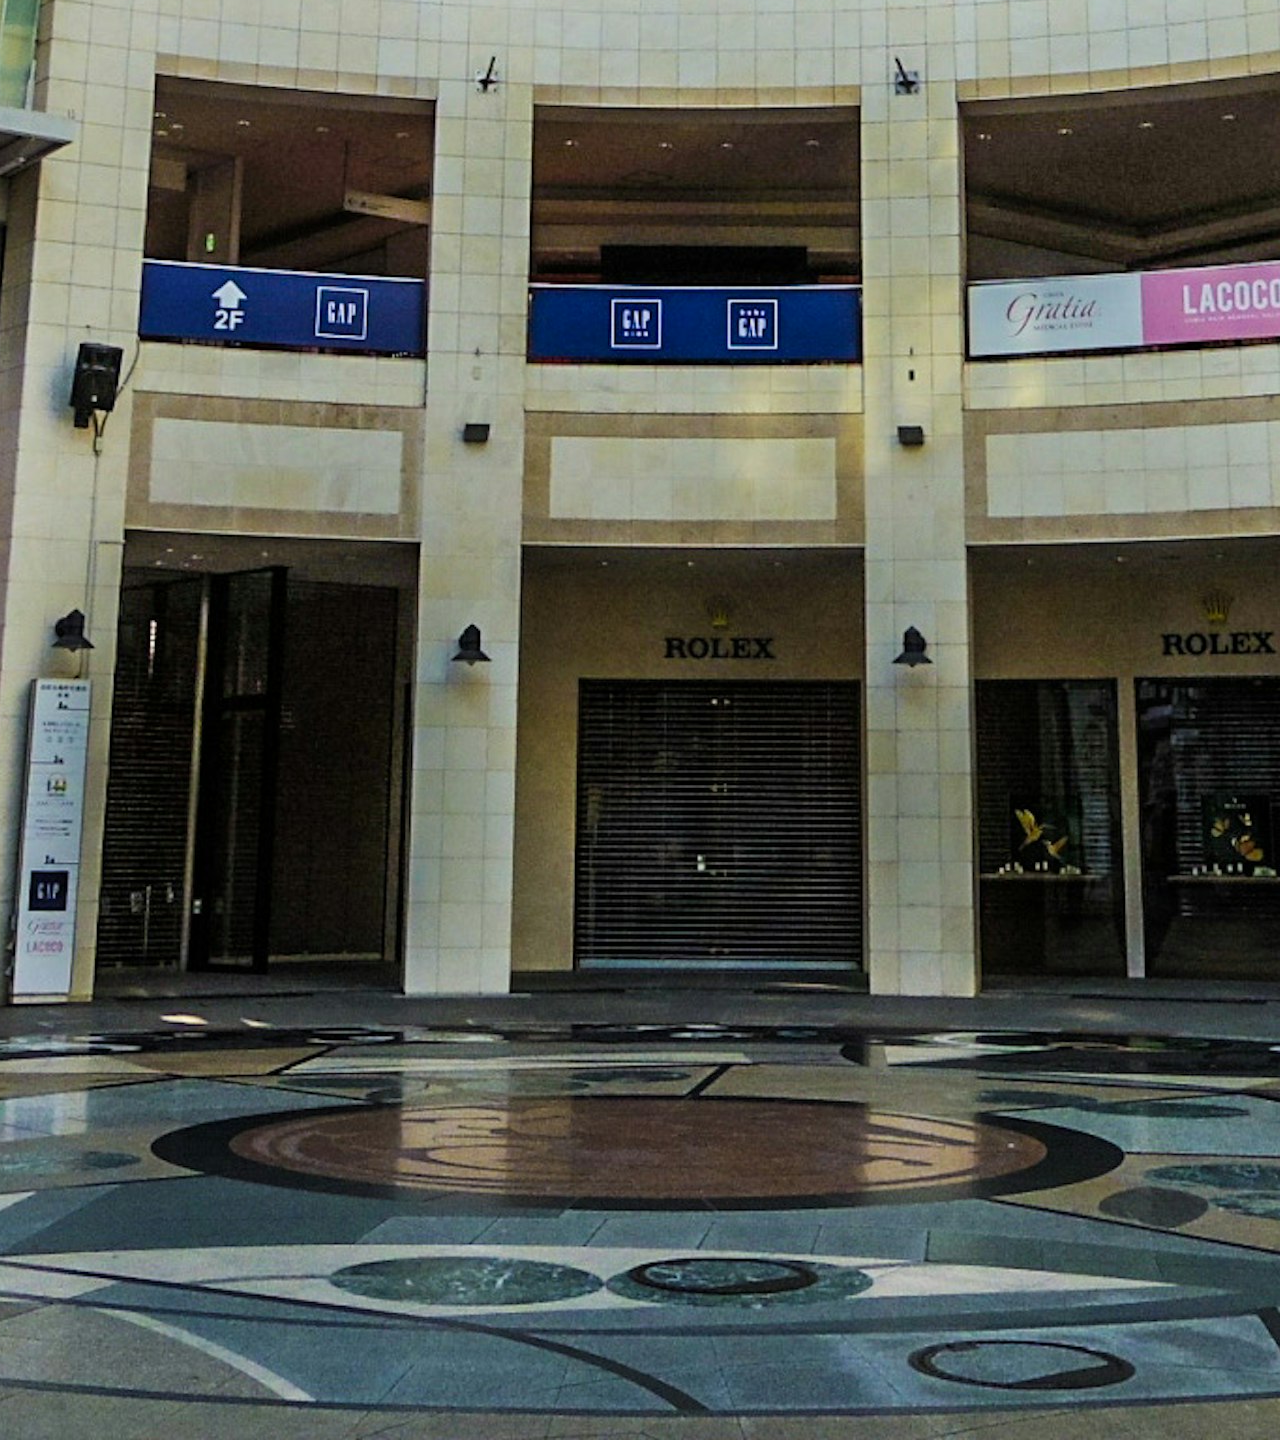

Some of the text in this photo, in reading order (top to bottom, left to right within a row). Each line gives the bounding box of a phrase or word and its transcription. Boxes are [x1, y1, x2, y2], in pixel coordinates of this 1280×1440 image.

[213, 310, 246, 331] 2F
[327, 301, 357, 325] GAP
[622, 309, 651, 330] GAP
[1007, 292, 1096, 337] Gratia
[738, 317, 767, 338] GAP
[664, 637, 776, 659] ROLEX
[1161, 631, 1277, 656] ROLEX
